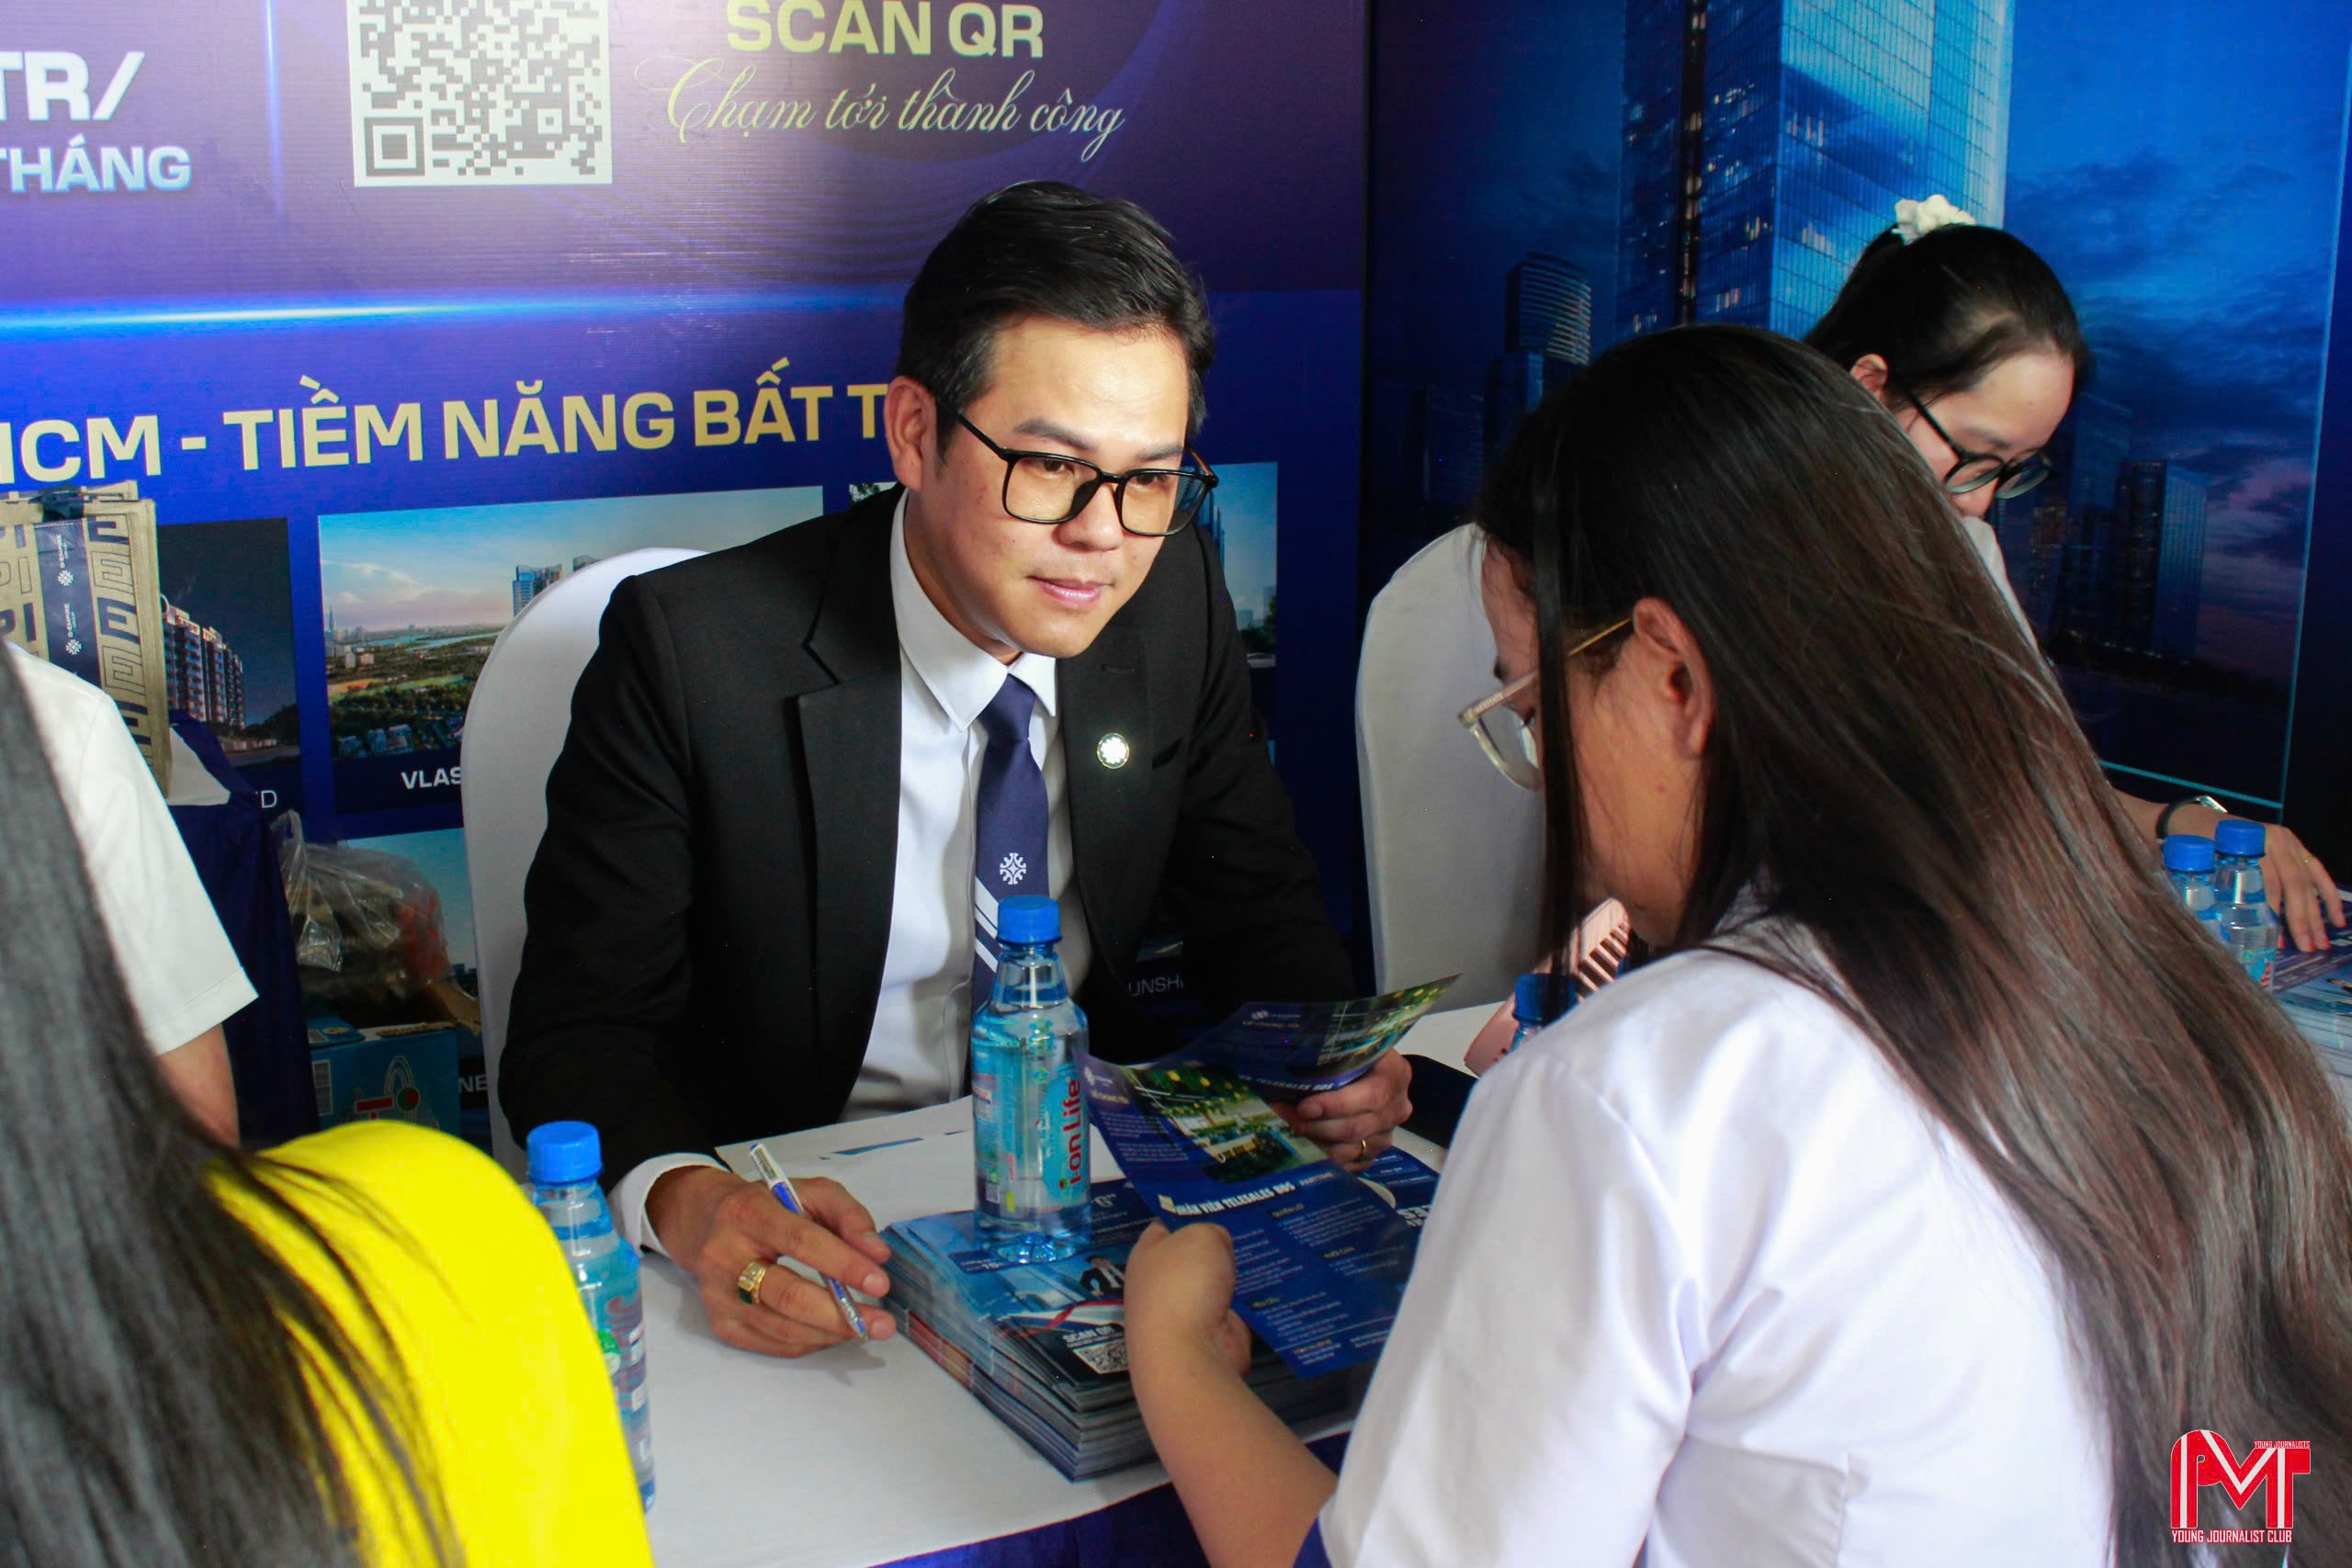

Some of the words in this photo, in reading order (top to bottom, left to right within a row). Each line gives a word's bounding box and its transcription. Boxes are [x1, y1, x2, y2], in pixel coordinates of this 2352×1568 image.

[726, 0, 932, 55] SCAN
[948, 2, 1044, 58] QR
[634, 55, 816, 143] Chạm
[825, 83, 888, 131] tới
[898, 67, 1036, 132] thành
[1029, 88, 1126, 163] công
[0, 132, 192, 193] HÁNG
[222, 375, 424, 470] TIỀM
[443, 379, 675, 460] NĂNG
[694, 356, 833, 446] BẤT
[1062, 1079, 1081, 1132] Life
